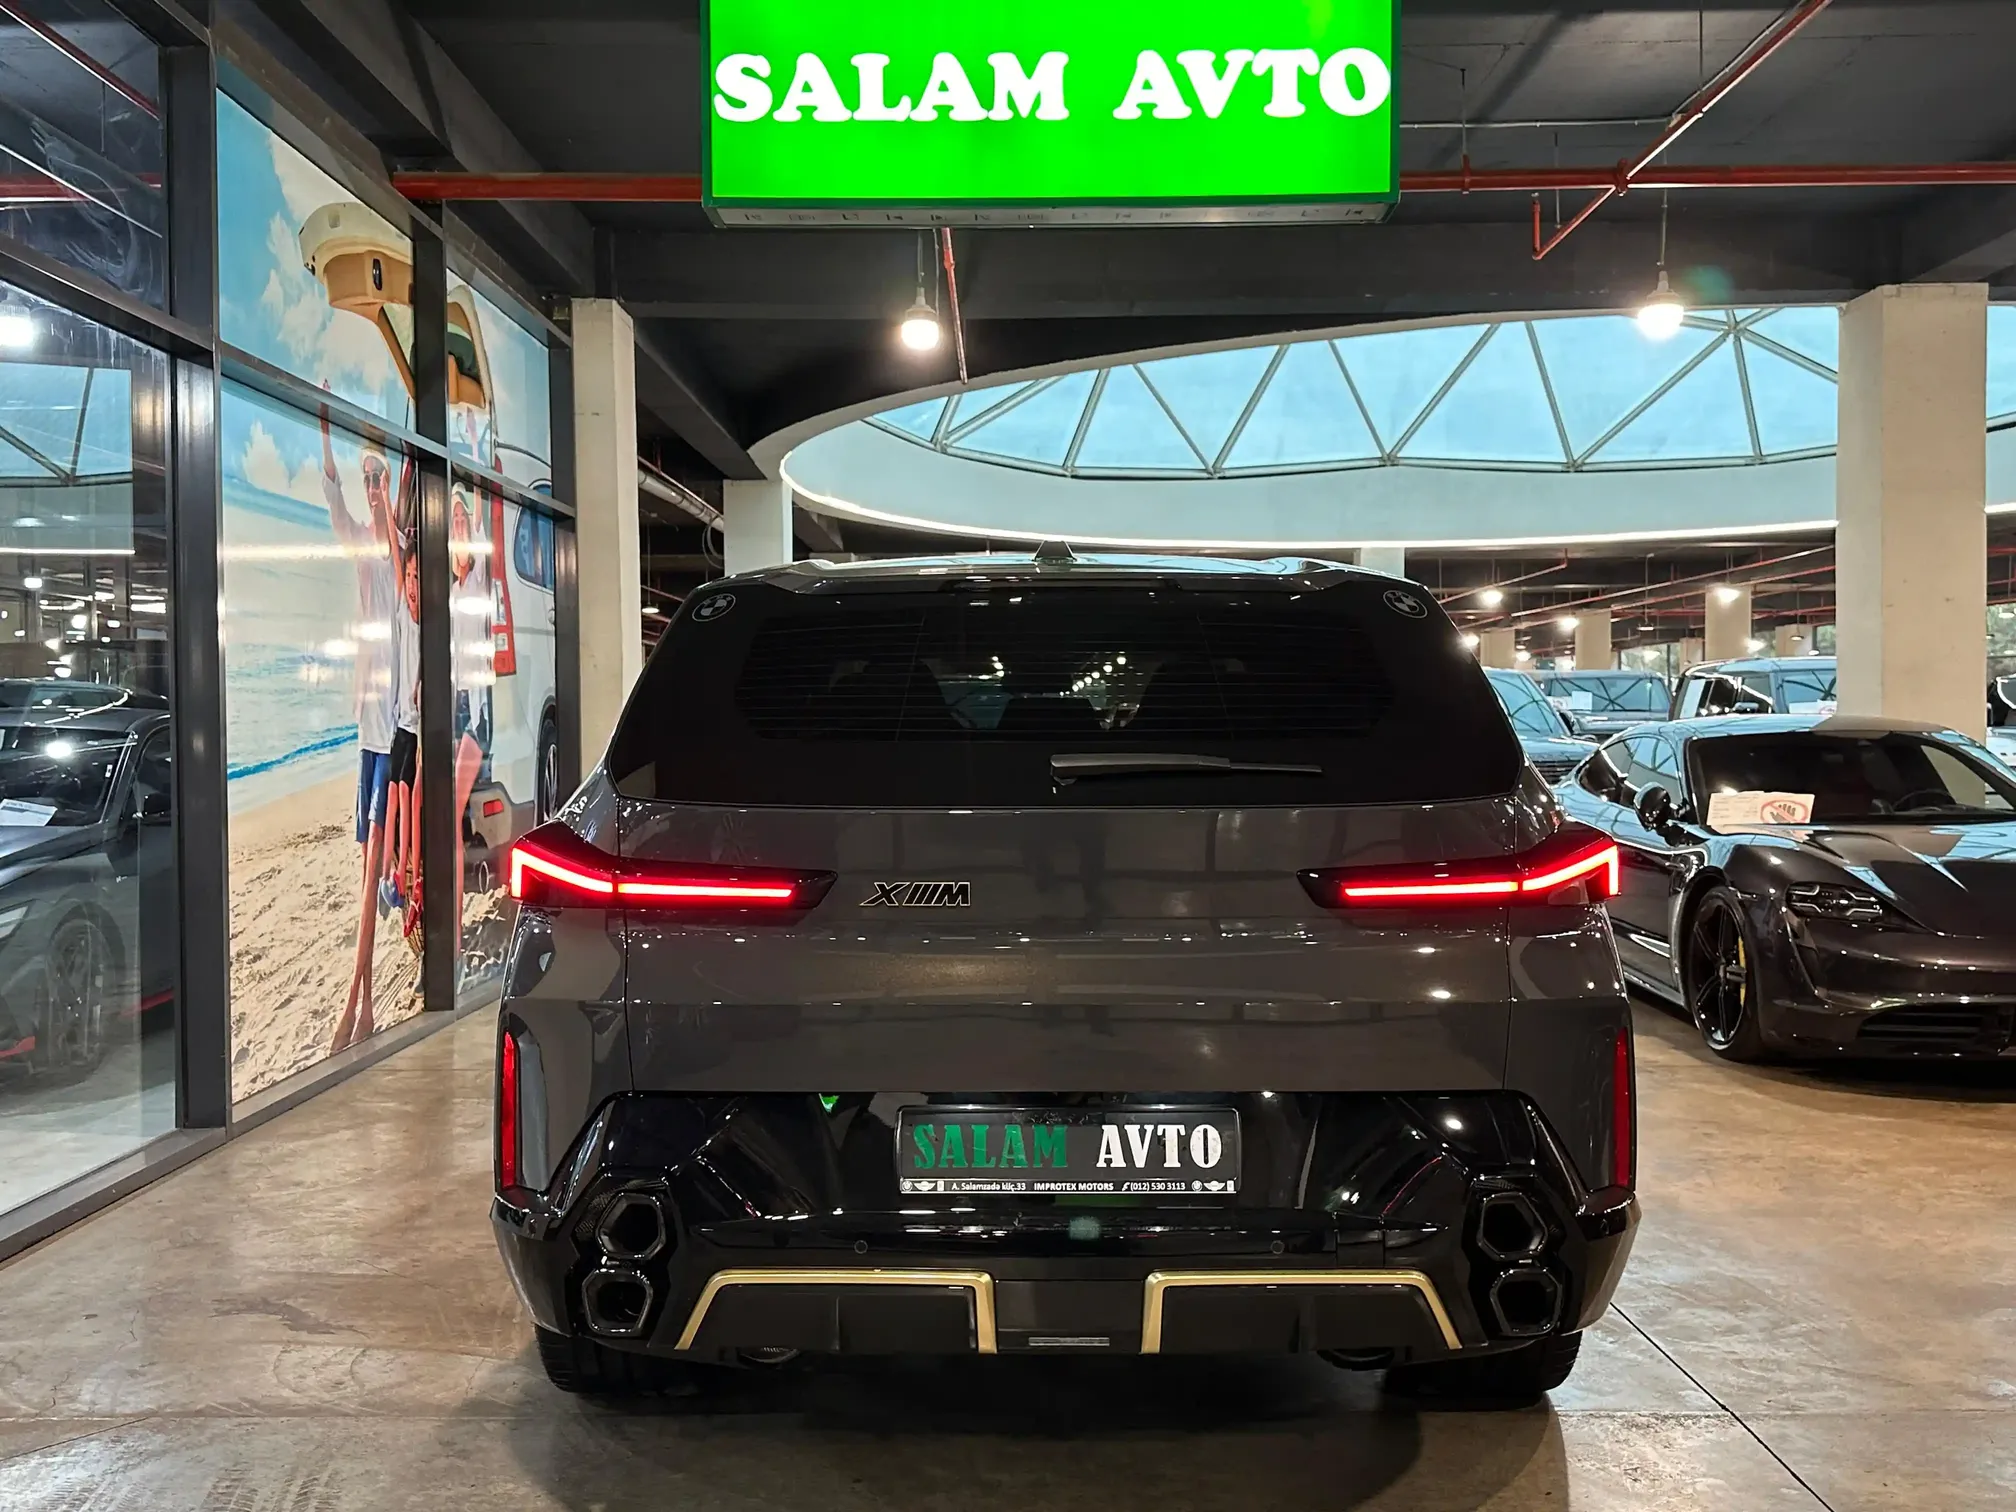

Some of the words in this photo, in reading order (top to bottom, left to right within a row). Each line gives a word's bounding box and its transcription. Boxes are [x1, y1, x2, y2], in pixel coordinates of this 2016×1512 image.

[713, 51, 1069, 123] SALAM
[1112, 47, 1391, 119] AVTO
[913, 1124, 1068, 1169] SALAM
[1096, 1124, 1222, 1169] AVTO
[951, 1182, 960, 1191] A.
[1034, 1182, 1077, 1191] IMPROTEX
[1078, 1182, 1114, 1191] MOTORS
[1130, 1182, 1150, 1192] (012)
[1151, 1182, 1166, 1191] 530
[1166, 1182, 1186, 1191] 3113
